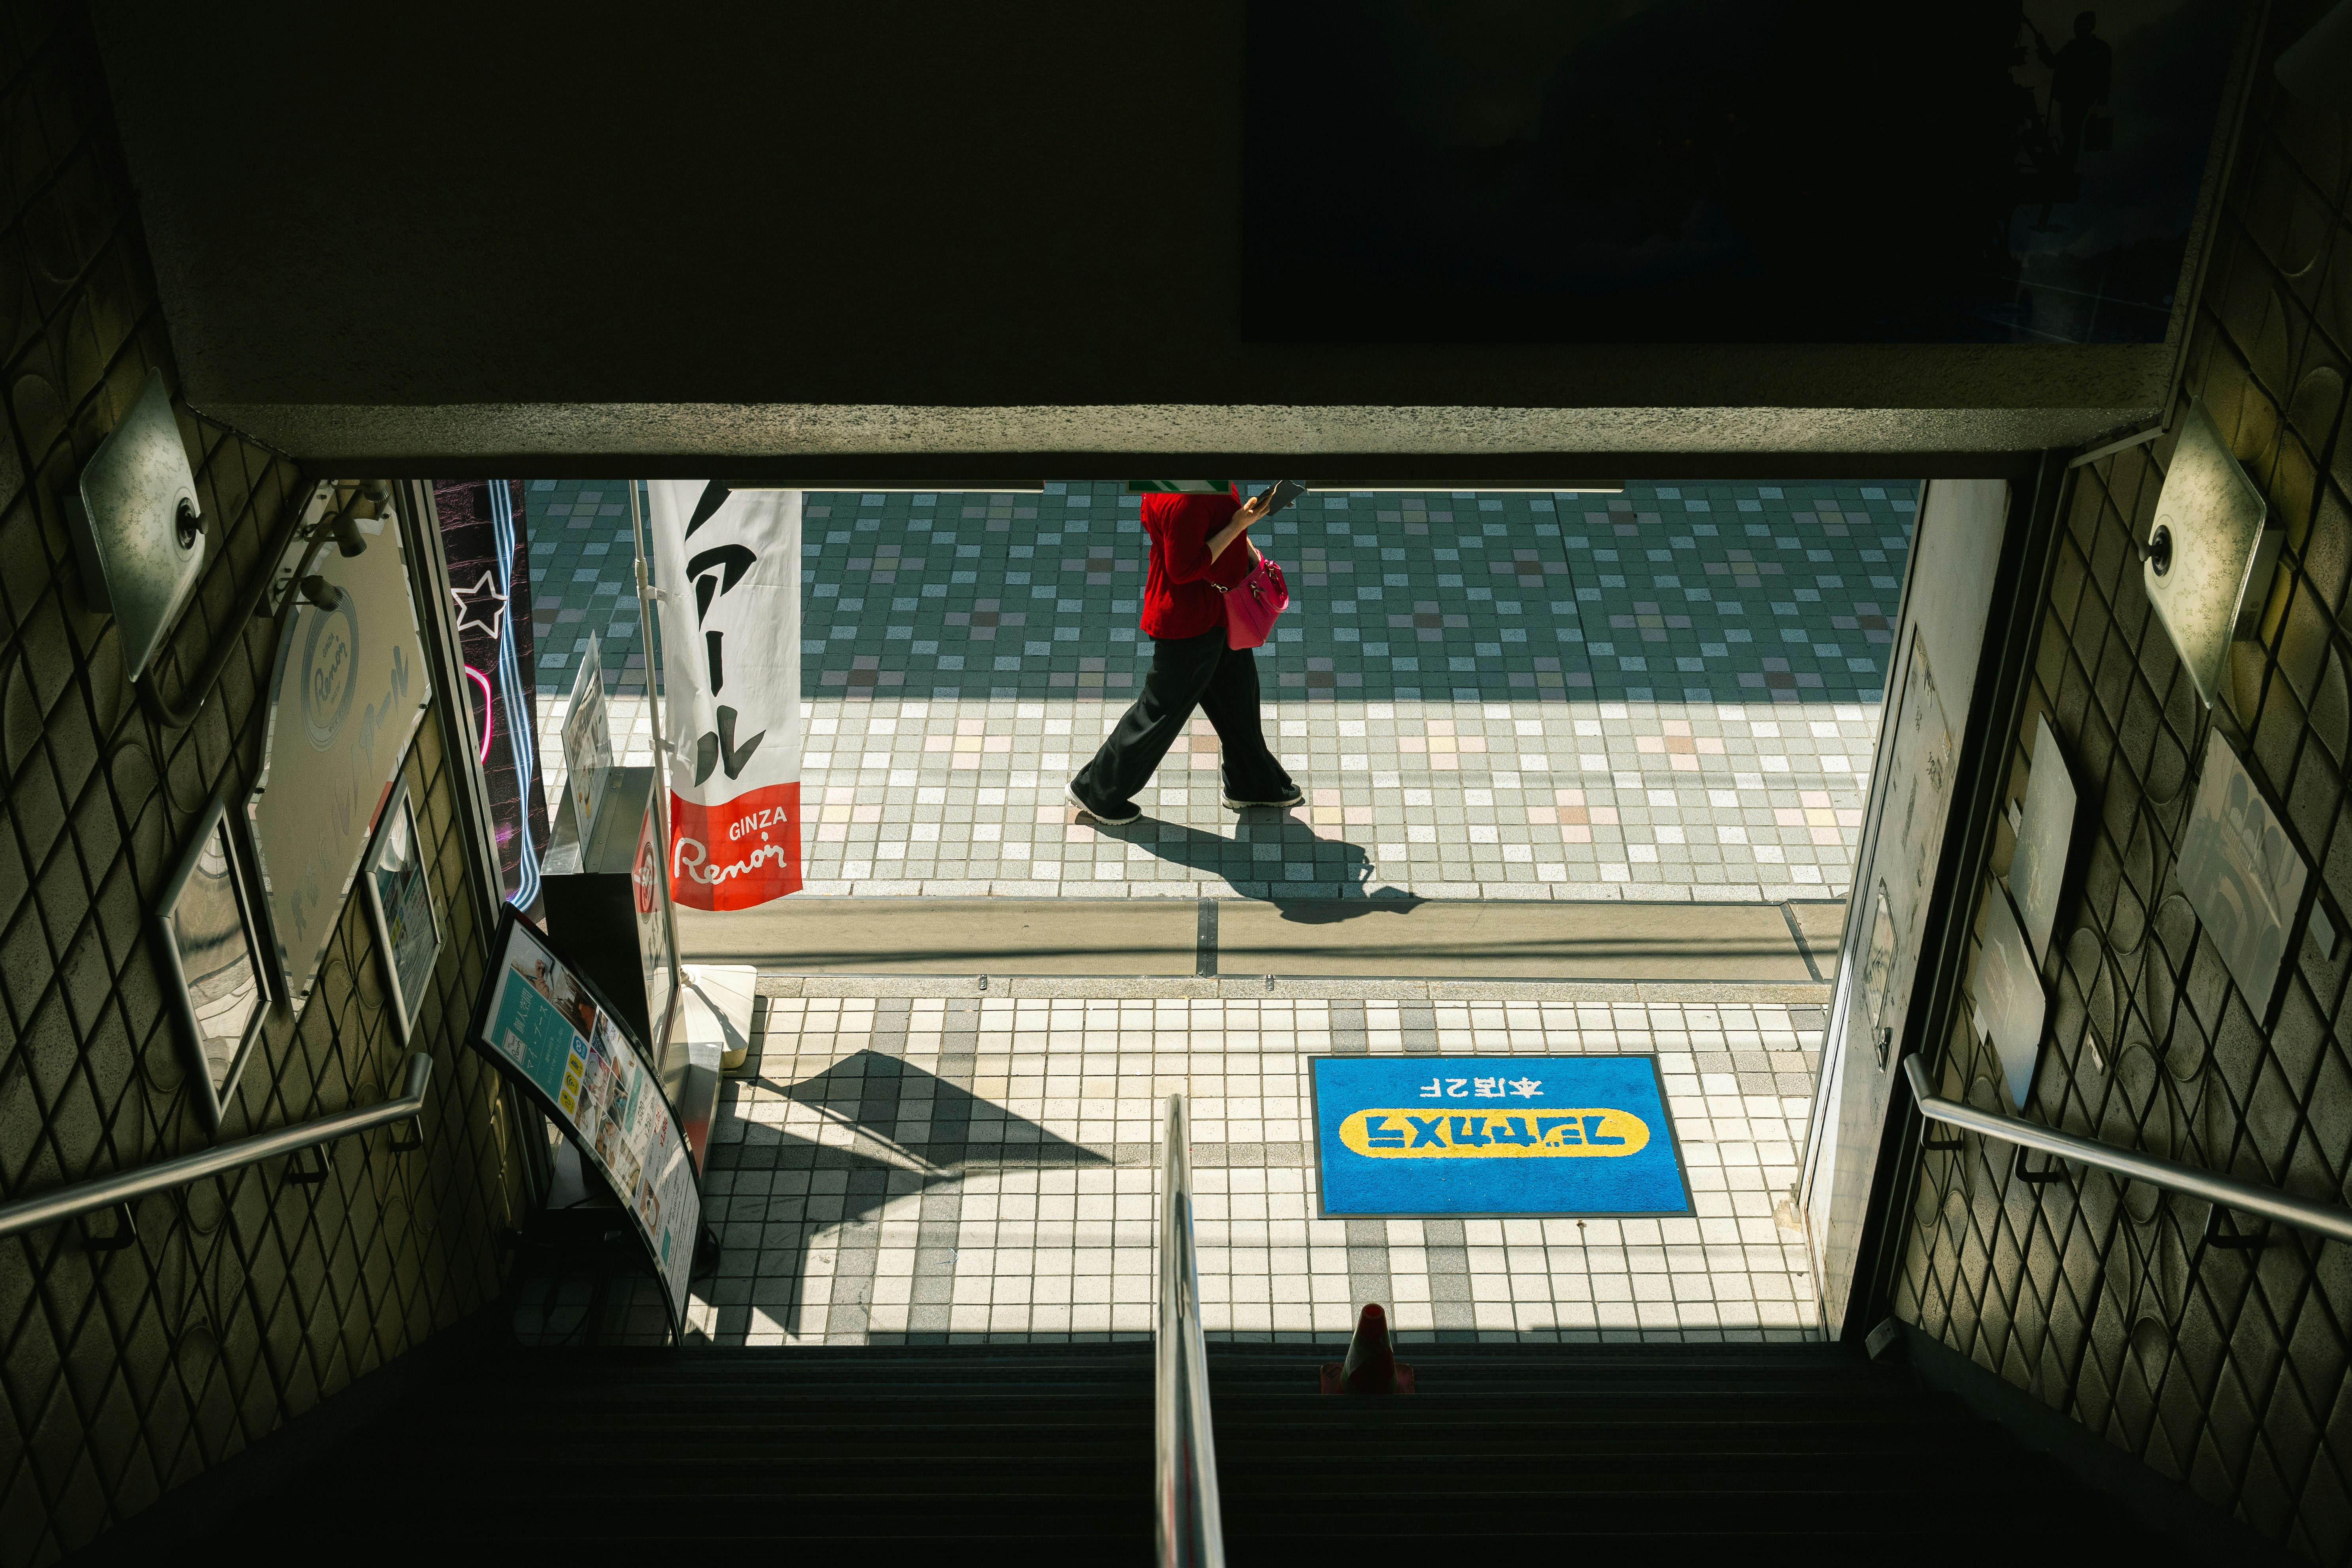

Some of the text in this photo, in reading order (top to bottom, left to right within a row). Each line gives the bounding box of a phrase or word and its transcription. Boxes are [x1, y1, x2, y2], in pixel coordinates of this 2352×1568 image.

[322, 632, 334, 658] GINZA
[315, 635, 347, 715] Renoir
[729, 806, 787, 841] GINZA
[675, 832, 787, 885] Renoir
[514, 987, 533, 1034] 個人空間
[1419, 1076, 1543, 1098] 本店2F
[1365, 1115, 1625, 1148] フジヤカメラ
